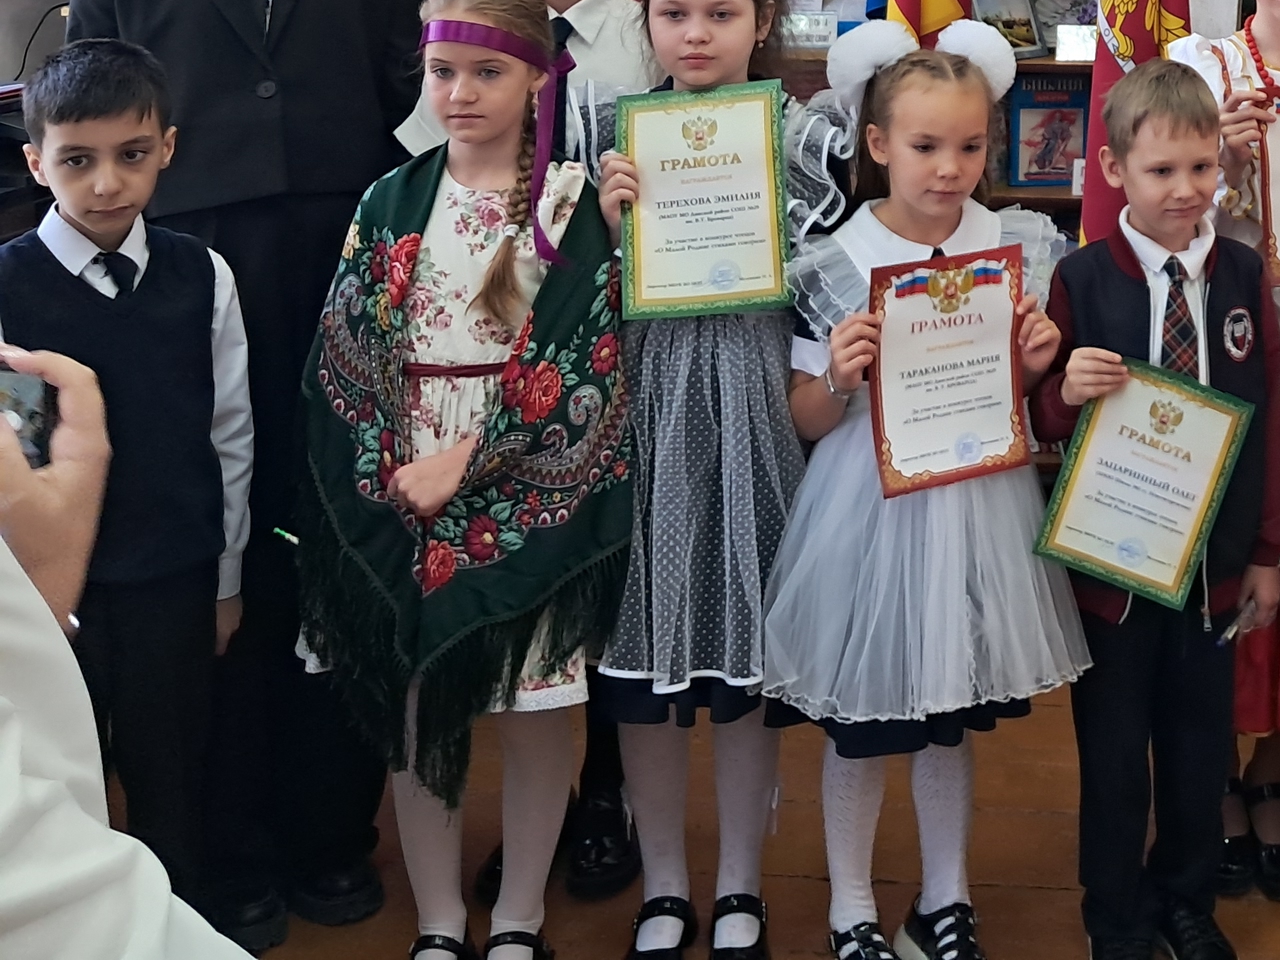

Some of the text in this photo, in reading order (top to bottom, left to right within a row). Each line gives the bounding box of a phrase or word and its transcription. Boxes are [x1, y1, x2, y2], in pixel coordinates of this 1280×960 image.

[660, 152, 741, 171] ГРАМОТА
[910, 311, 984, 335] ГРАМОТА
[1117, 424, 1194, 462] ГРАМОТА
